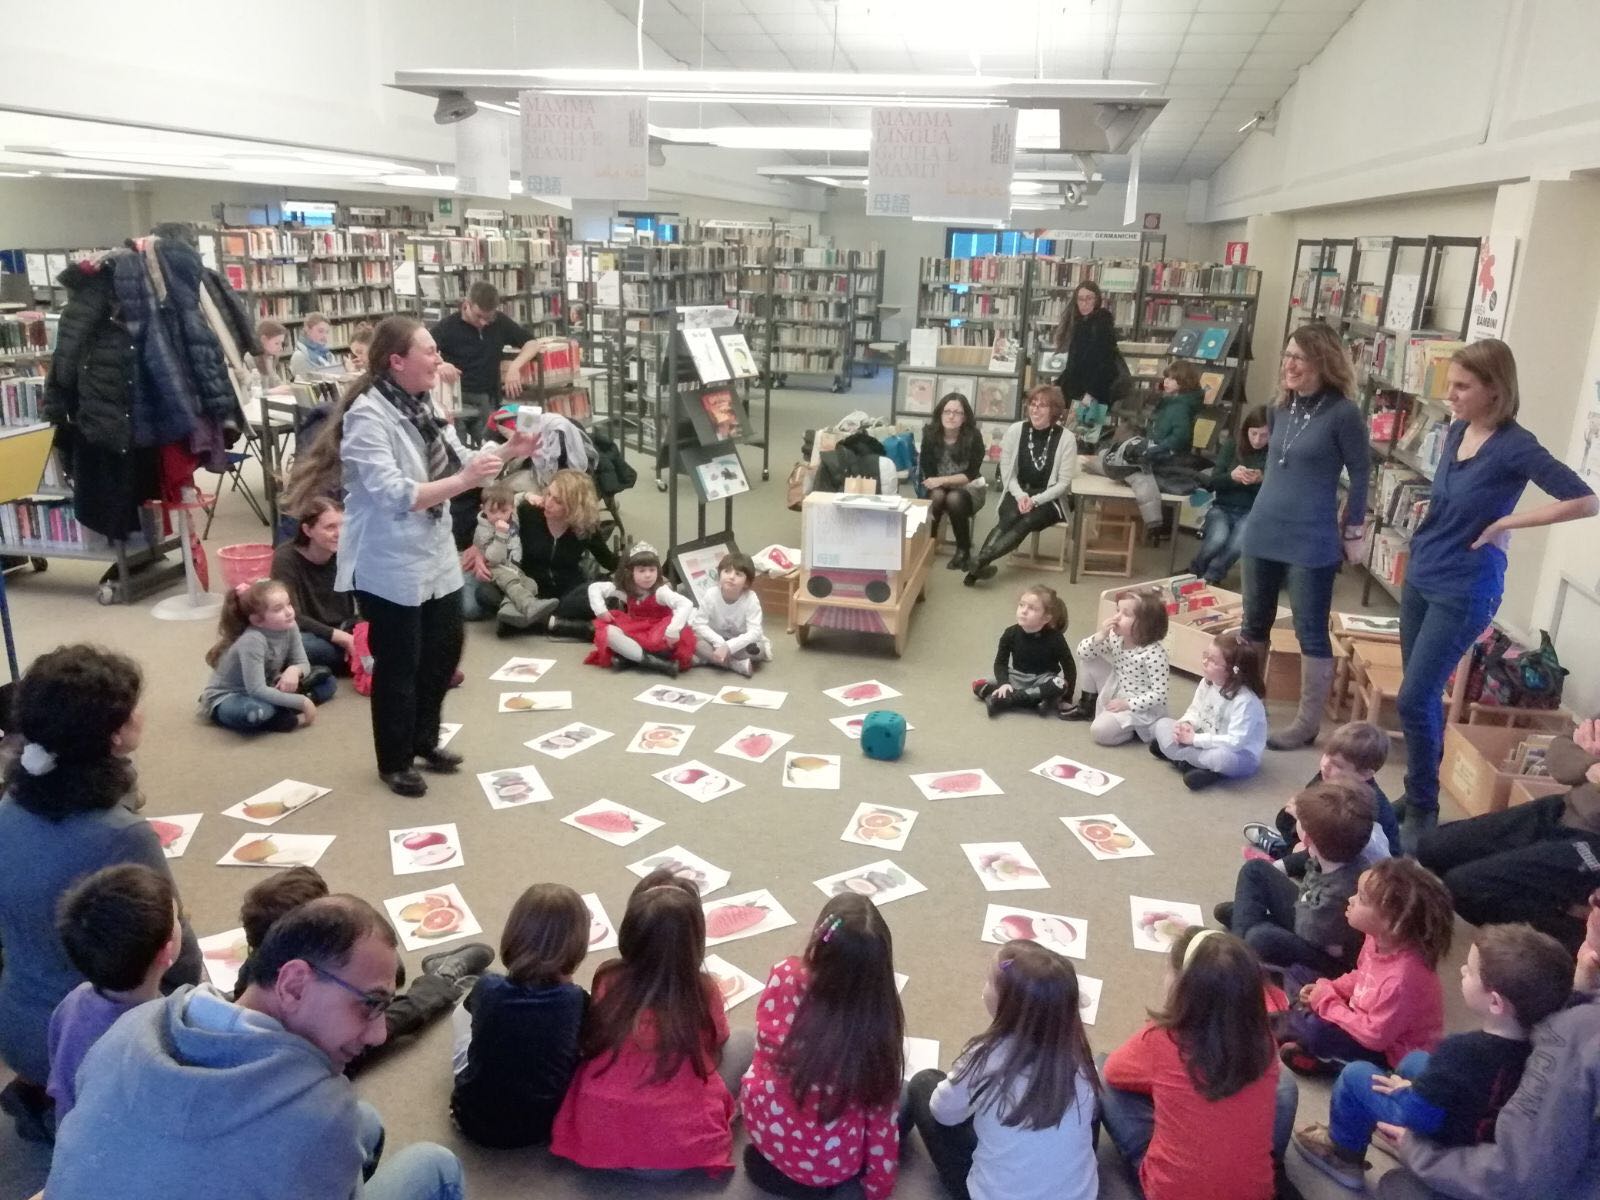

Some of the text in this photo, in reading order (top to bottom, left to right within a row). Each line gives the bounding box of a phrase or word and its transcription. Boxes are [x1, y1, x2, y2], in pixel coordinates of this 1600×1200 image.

[525, 97, 597, 114] MAMMA
[525, 113, 596, 130] LINGUA
[876, 111, 953, 128] MAMMA
[875, 128, 951, 145] LINGUA
[1094, 232, 1138, 240] GERMANICHE
[1476, 315, 1498, 329] BAMBINI
